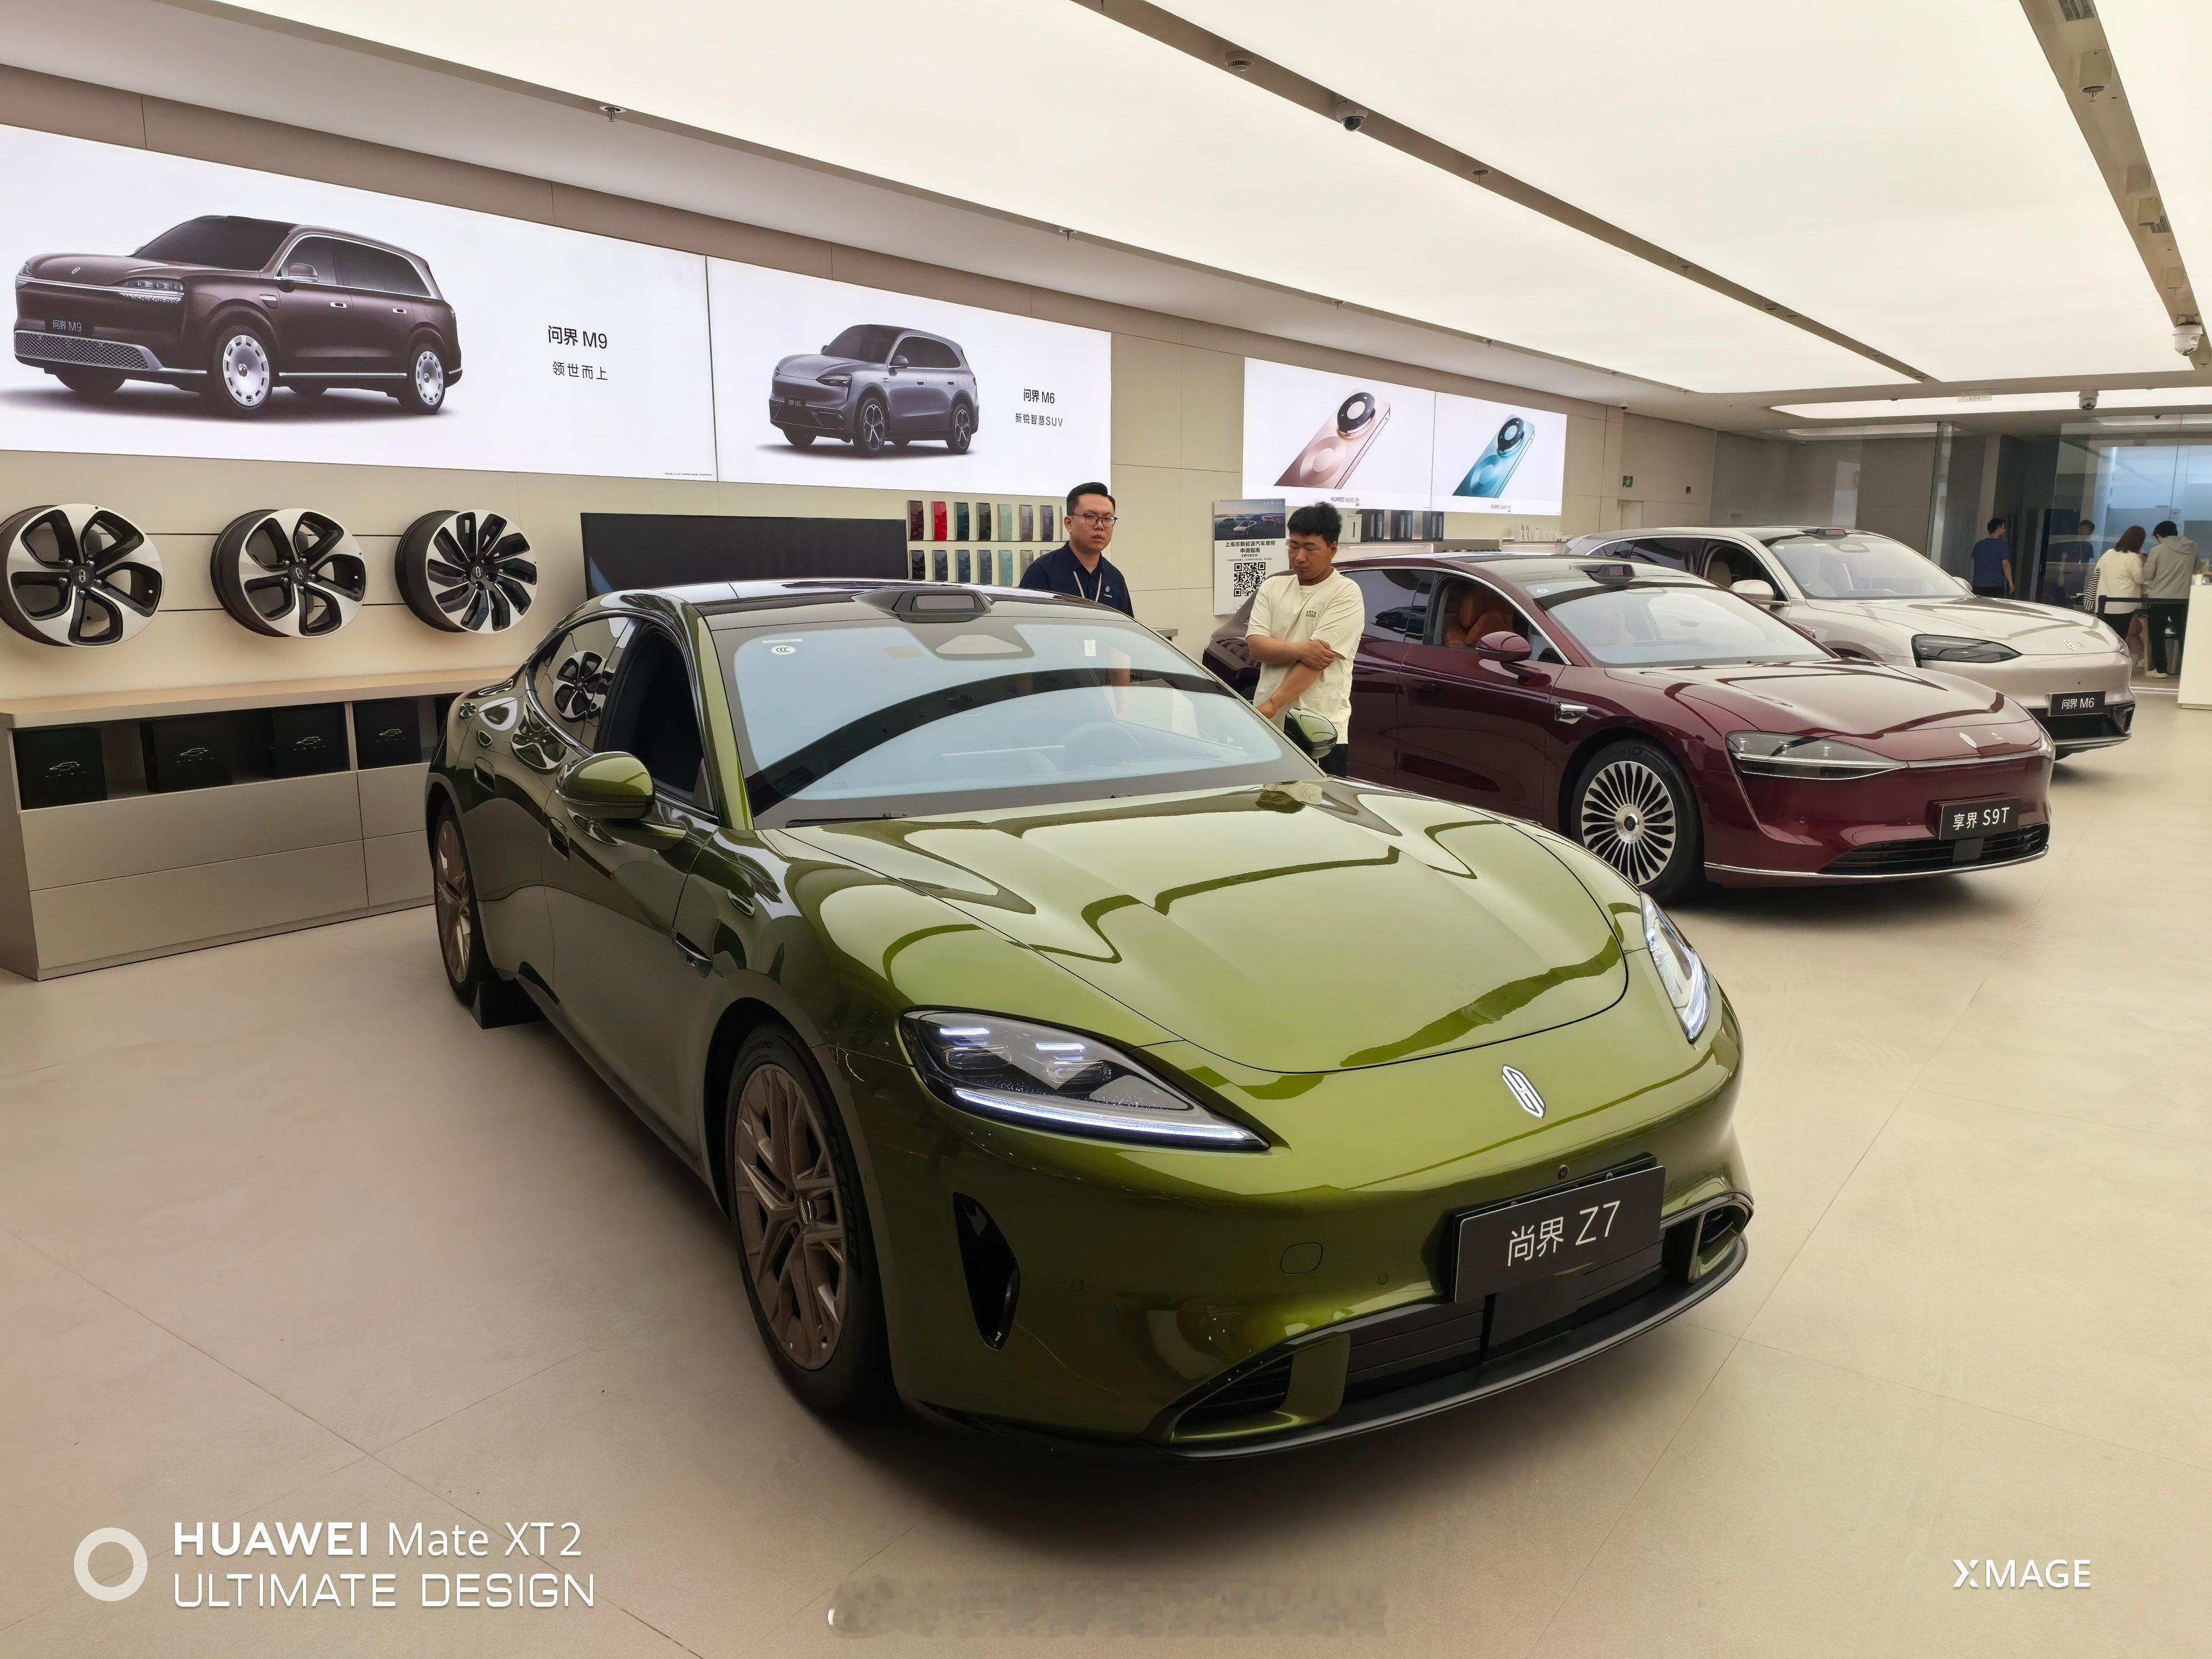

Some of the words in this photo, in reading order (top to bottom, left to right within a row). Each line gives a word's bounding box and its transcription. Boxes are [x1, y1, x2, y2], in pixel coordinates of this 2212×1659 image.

[53, 320, 66, 330] 问界
[69, 321, 82, 332] M9
[548, 325, 578, 346] 问界
[583, 331, 608, 349] M9
[552, 361, 608, 380] 领世而上
[1023, 388, 1040, 403] 问界
[1042, 391, 1055, 404] M6
[1015, 413, 1063, 427] 新锐智慧SUV
[2061, 698, 2078, 710] 问界
[2080, 697, 2094, 709] M6
[1952, 812, 1977, 831] 享界
[1982, 807, 2010, 826] S9T
[1507, 1216, 1564, 1267] 尚界
[1575, 1200, 1621, 1246] Z7
